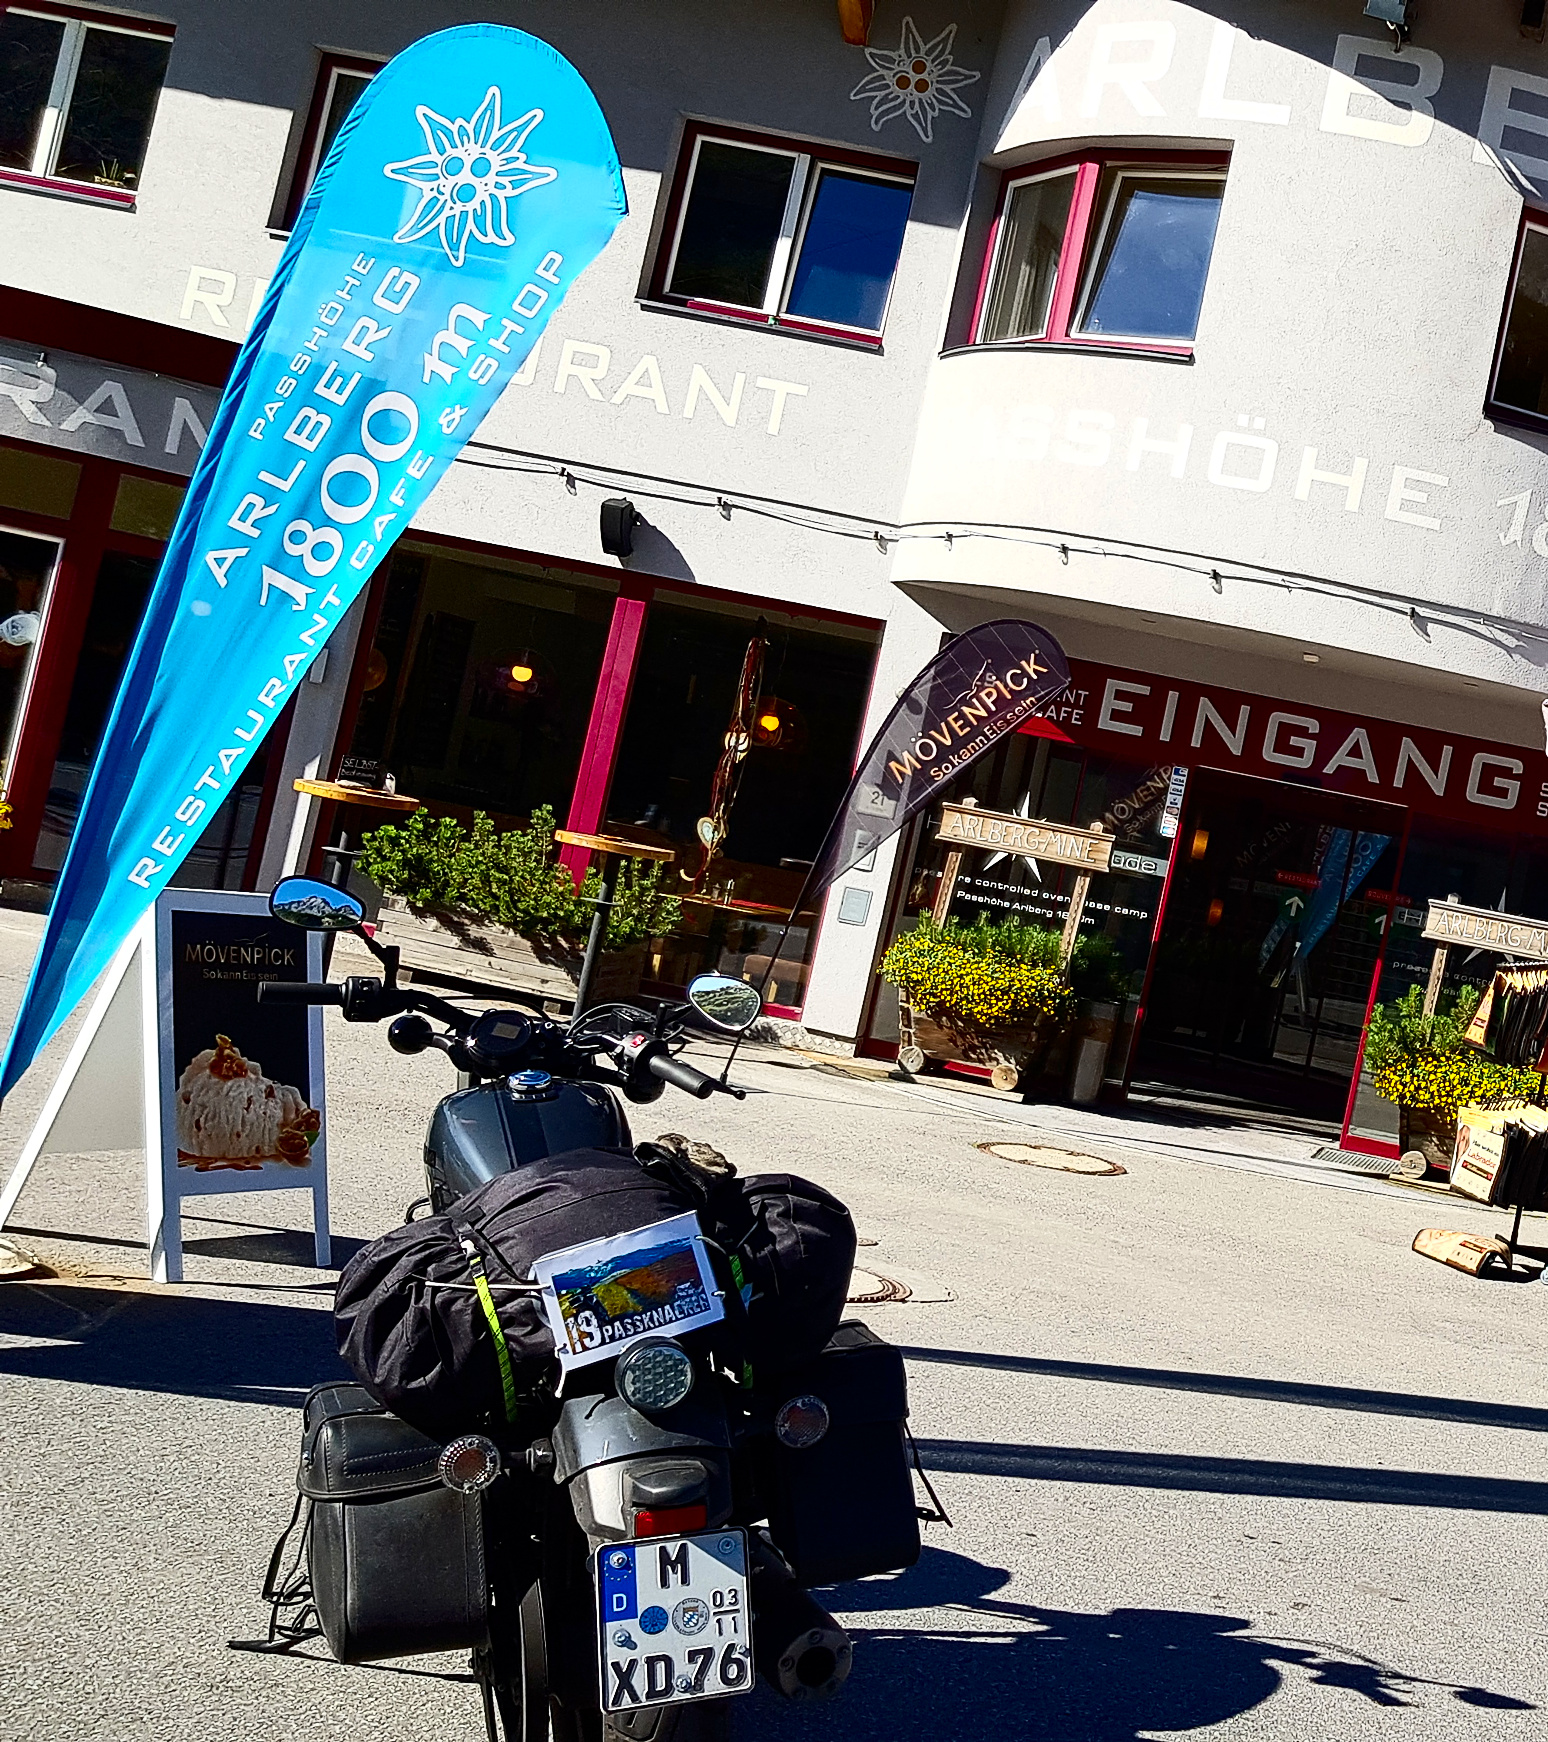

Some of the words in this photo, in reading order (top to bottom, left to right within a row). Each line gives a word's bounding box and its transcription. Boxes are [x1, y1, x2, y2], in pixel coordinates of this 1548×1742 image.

[250, 252, 376, 442] PASSHÖHE
[205, 266, 422, 590] ARLBERG
[258, 391, 420, 614] 1800
[423, 302, 492, 388] m
[128, 586, 344, 890] RESTAURANT
[349, 449, 435, 572] CAFE
[437, 402, 470, 438] &
[468, 250, 566, 387] SHOP
[1006, 695, 1038, 724] sein
[1032, 704, 1084, 726] AFE
[1097, 678, 1524, 811] EINGANG
[871, 790, 886, 807] 21
[948, 813, 1099, 864] ARLBERG-MINE
[975, 878, 1039, 897] controlled
[1042, 892, 1071, 904] oven
[1114, 906, 1148, 920] camp
[1011, 902, 1053, 918] Arlberg
[657, 1541, 691, 1590] M
[612, 1592, 627, 1612] D
[711, 1587, 740, 1609] 03
[715, 1615, 739, 1638] 11
[609, 1653, 675, 1708] XD
[685, 1641, 749, 1696] 76
